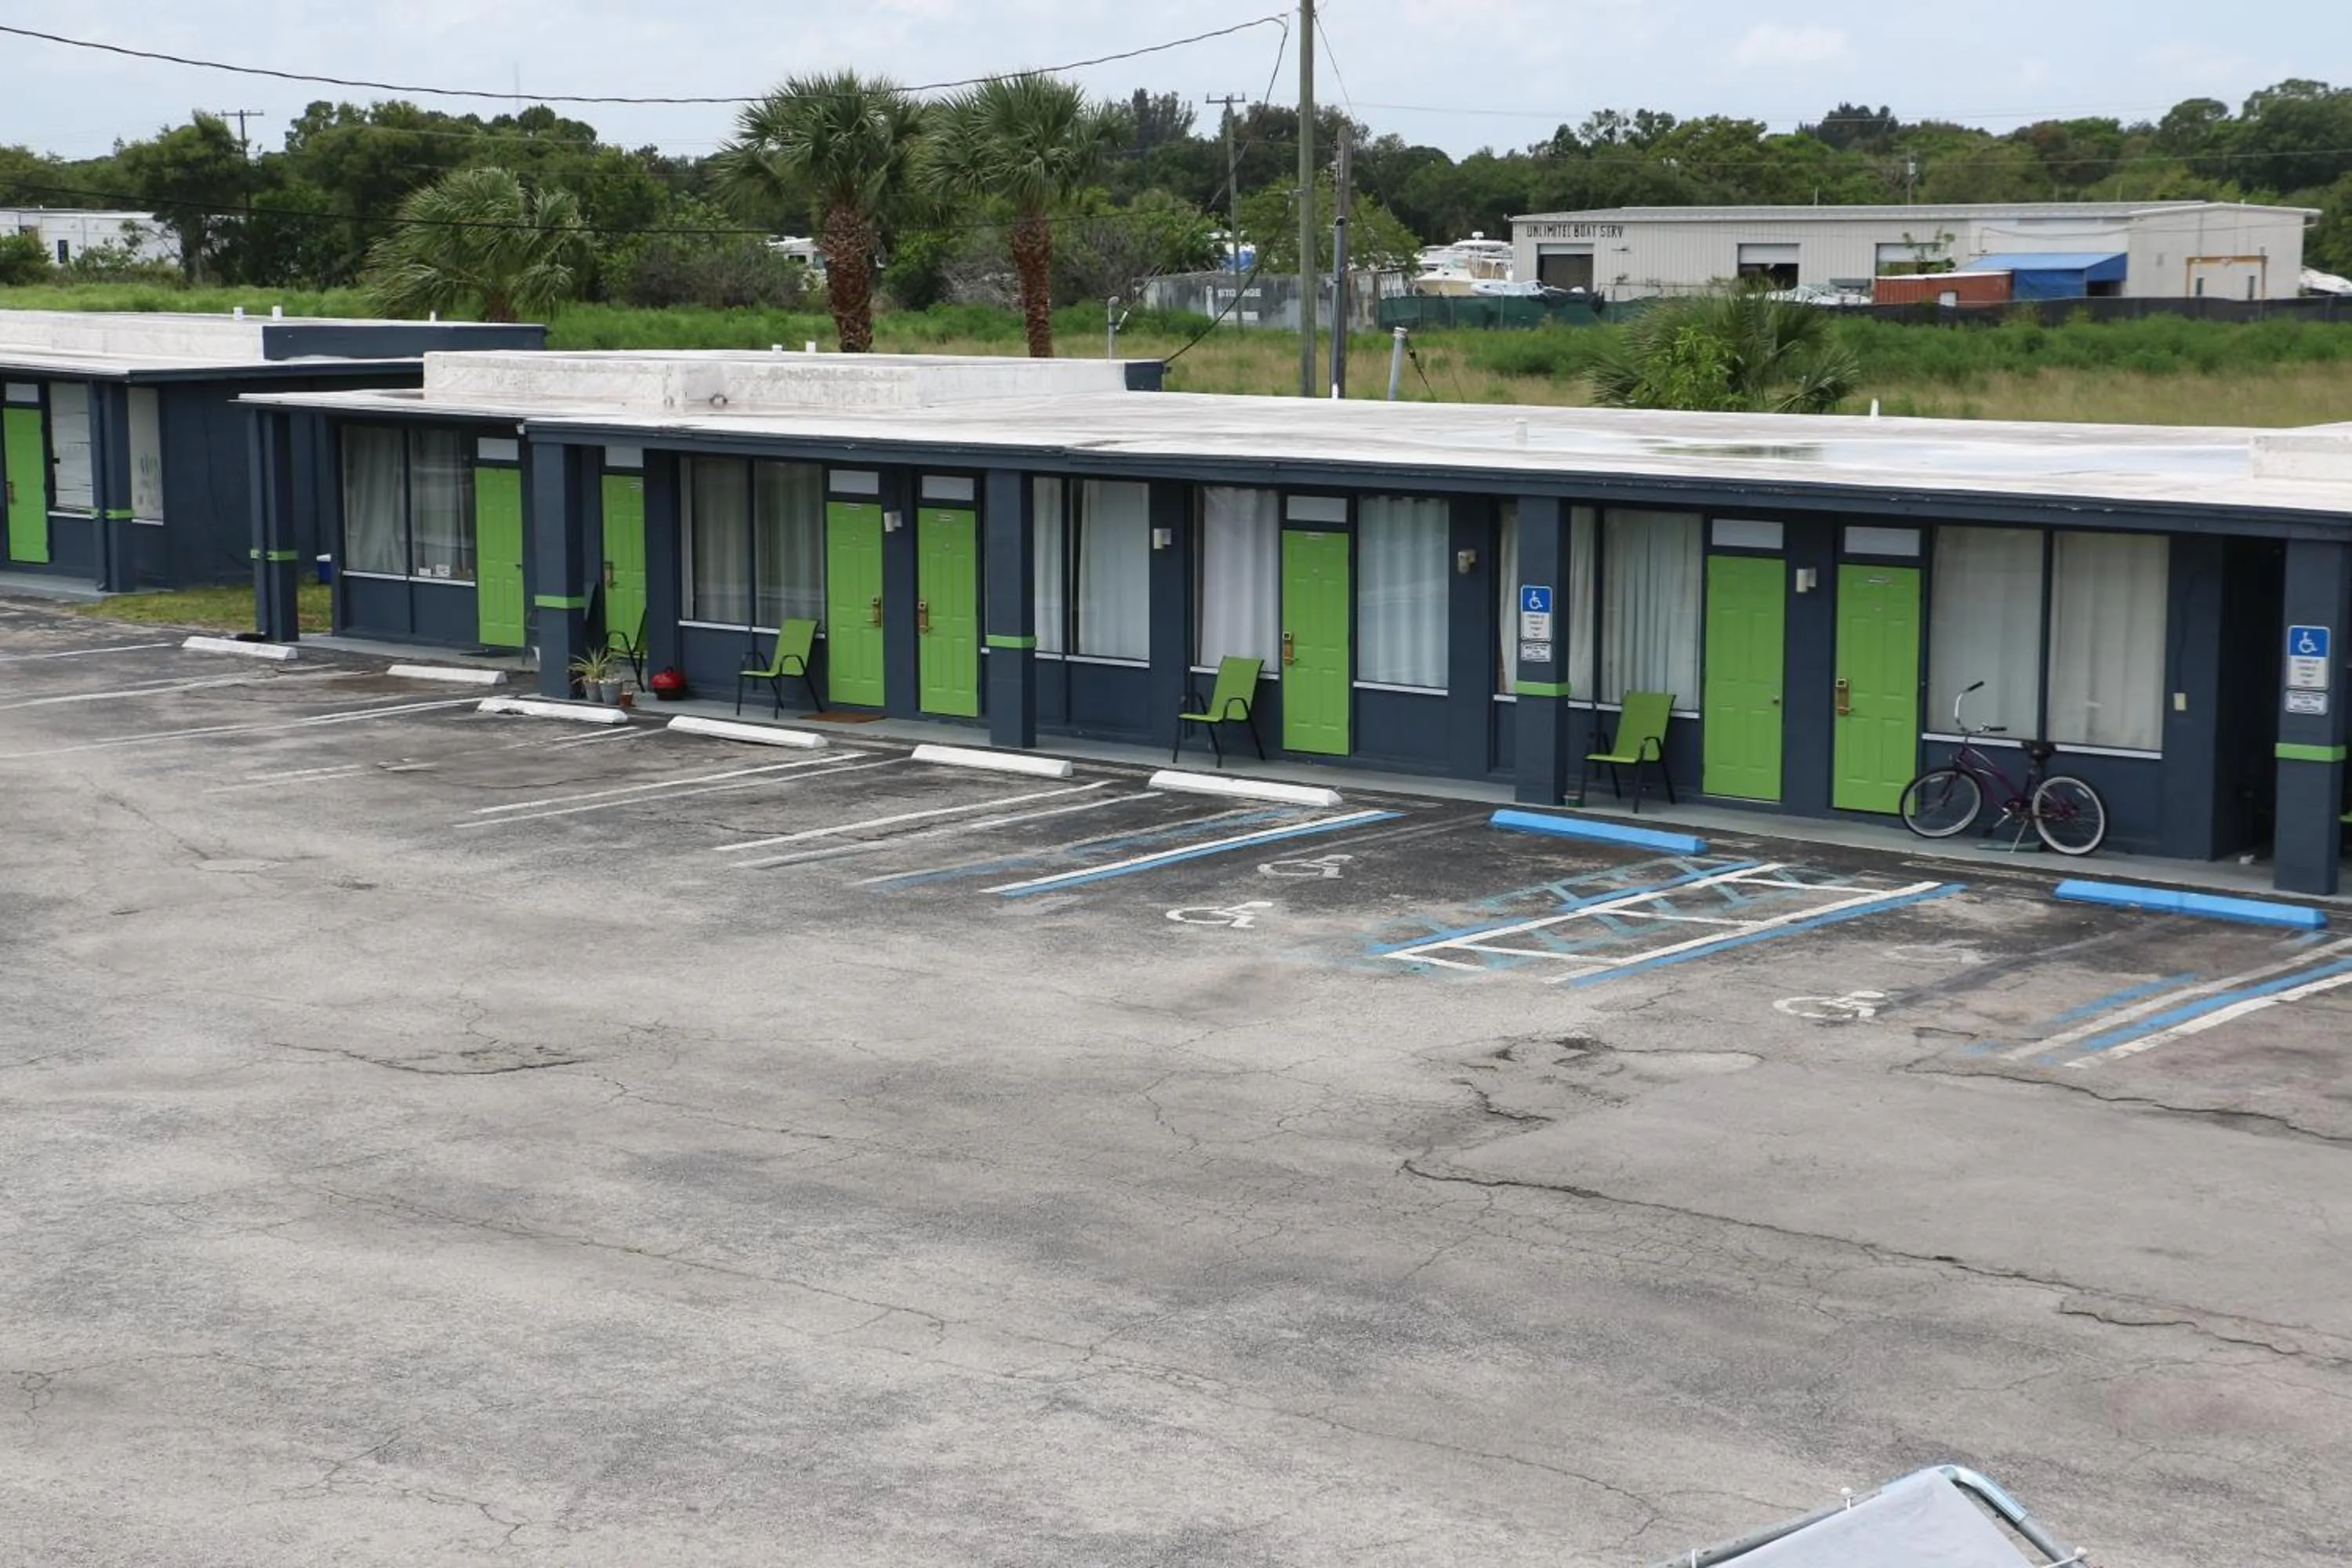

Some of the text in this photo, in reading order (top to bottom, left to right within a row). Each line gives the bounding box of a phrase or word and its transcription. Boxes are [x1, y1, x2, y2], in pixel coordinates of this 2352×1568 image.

[1573, 224, 1596, 238] BOAT
[1600, 225, 1624, 238] SERV
[1218, 288, 1261, 297] STOAGE
